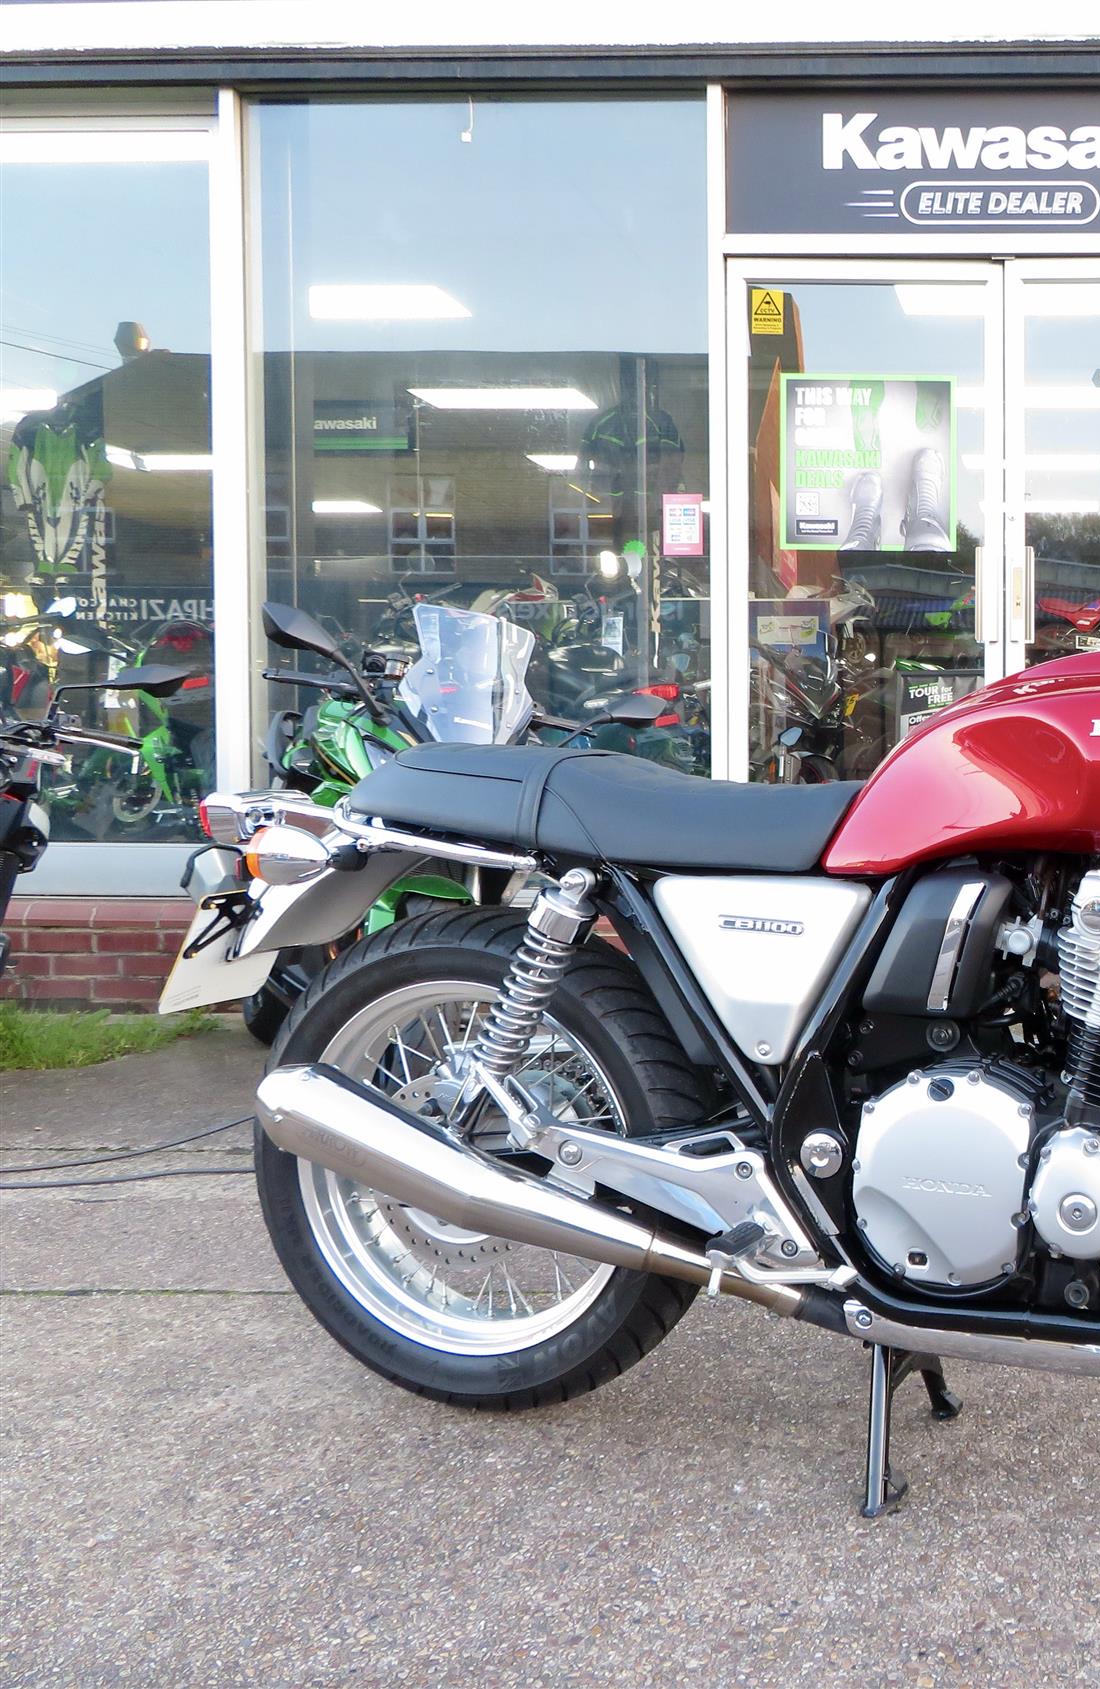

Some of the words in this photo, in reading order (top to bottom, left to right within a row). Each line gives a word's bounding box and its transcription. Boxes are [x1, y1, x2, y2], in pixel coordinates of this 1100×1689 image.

[918, 191, 983, 214] ELITE
[989, 191, 1084, 214] DEALER
[795, 388, 832, 405] THIS
[836, 388, 872, 405] WAY
[313, 417, 377, 430] awasaki
[795, 450, 881, 468] KAWASAKI
[795, 470, 845, 488] DEALS
[908, 686, 939, 699] TOUR
[927, 693, 953, 704] FREE
[718, 914, 804, 935] CB1100
[901, 1176, 993, 1197] HONDA
